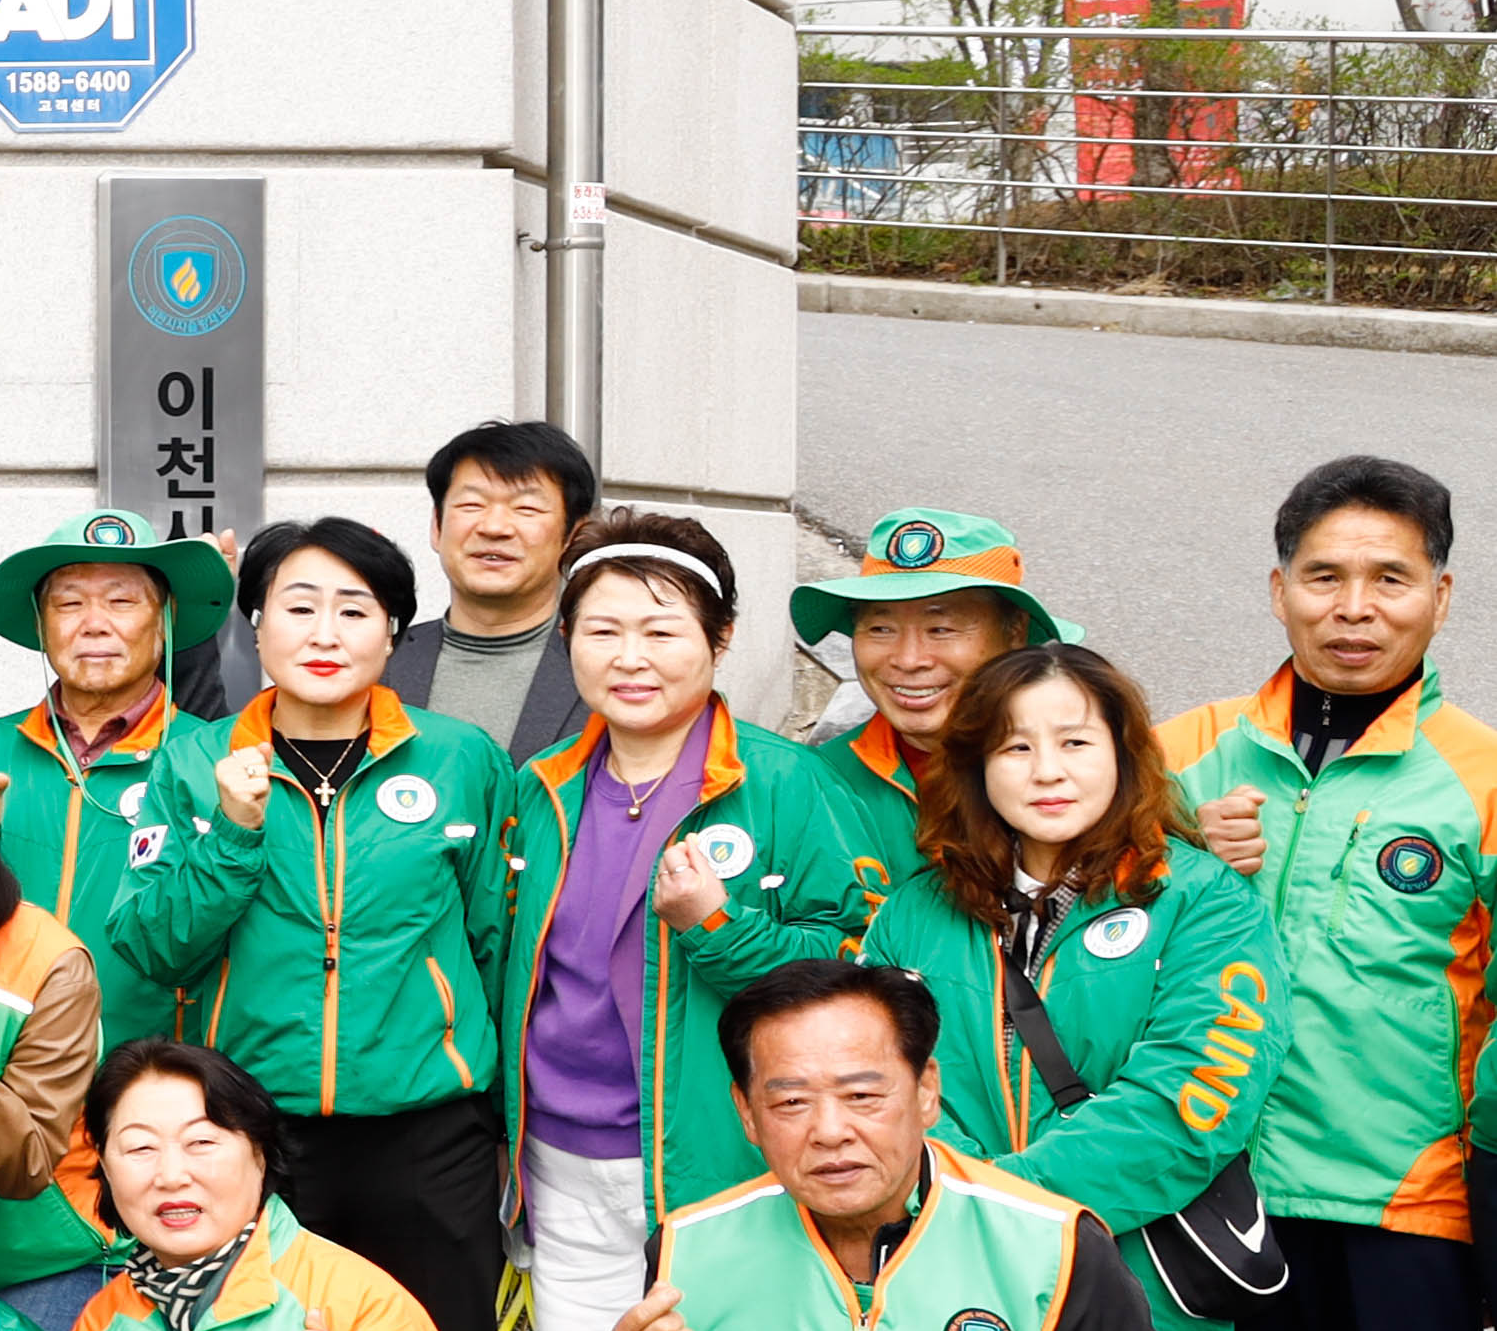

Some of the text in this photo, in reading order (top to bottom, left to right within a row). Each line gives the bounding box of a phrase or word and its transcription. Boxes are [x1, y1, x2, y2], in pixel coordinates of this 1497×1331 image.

[6, 70, 131, 94] 1588-6400
[38, 98, 102, 113] 고객센터
[1176, 961, 1268, 1134] CAIND
